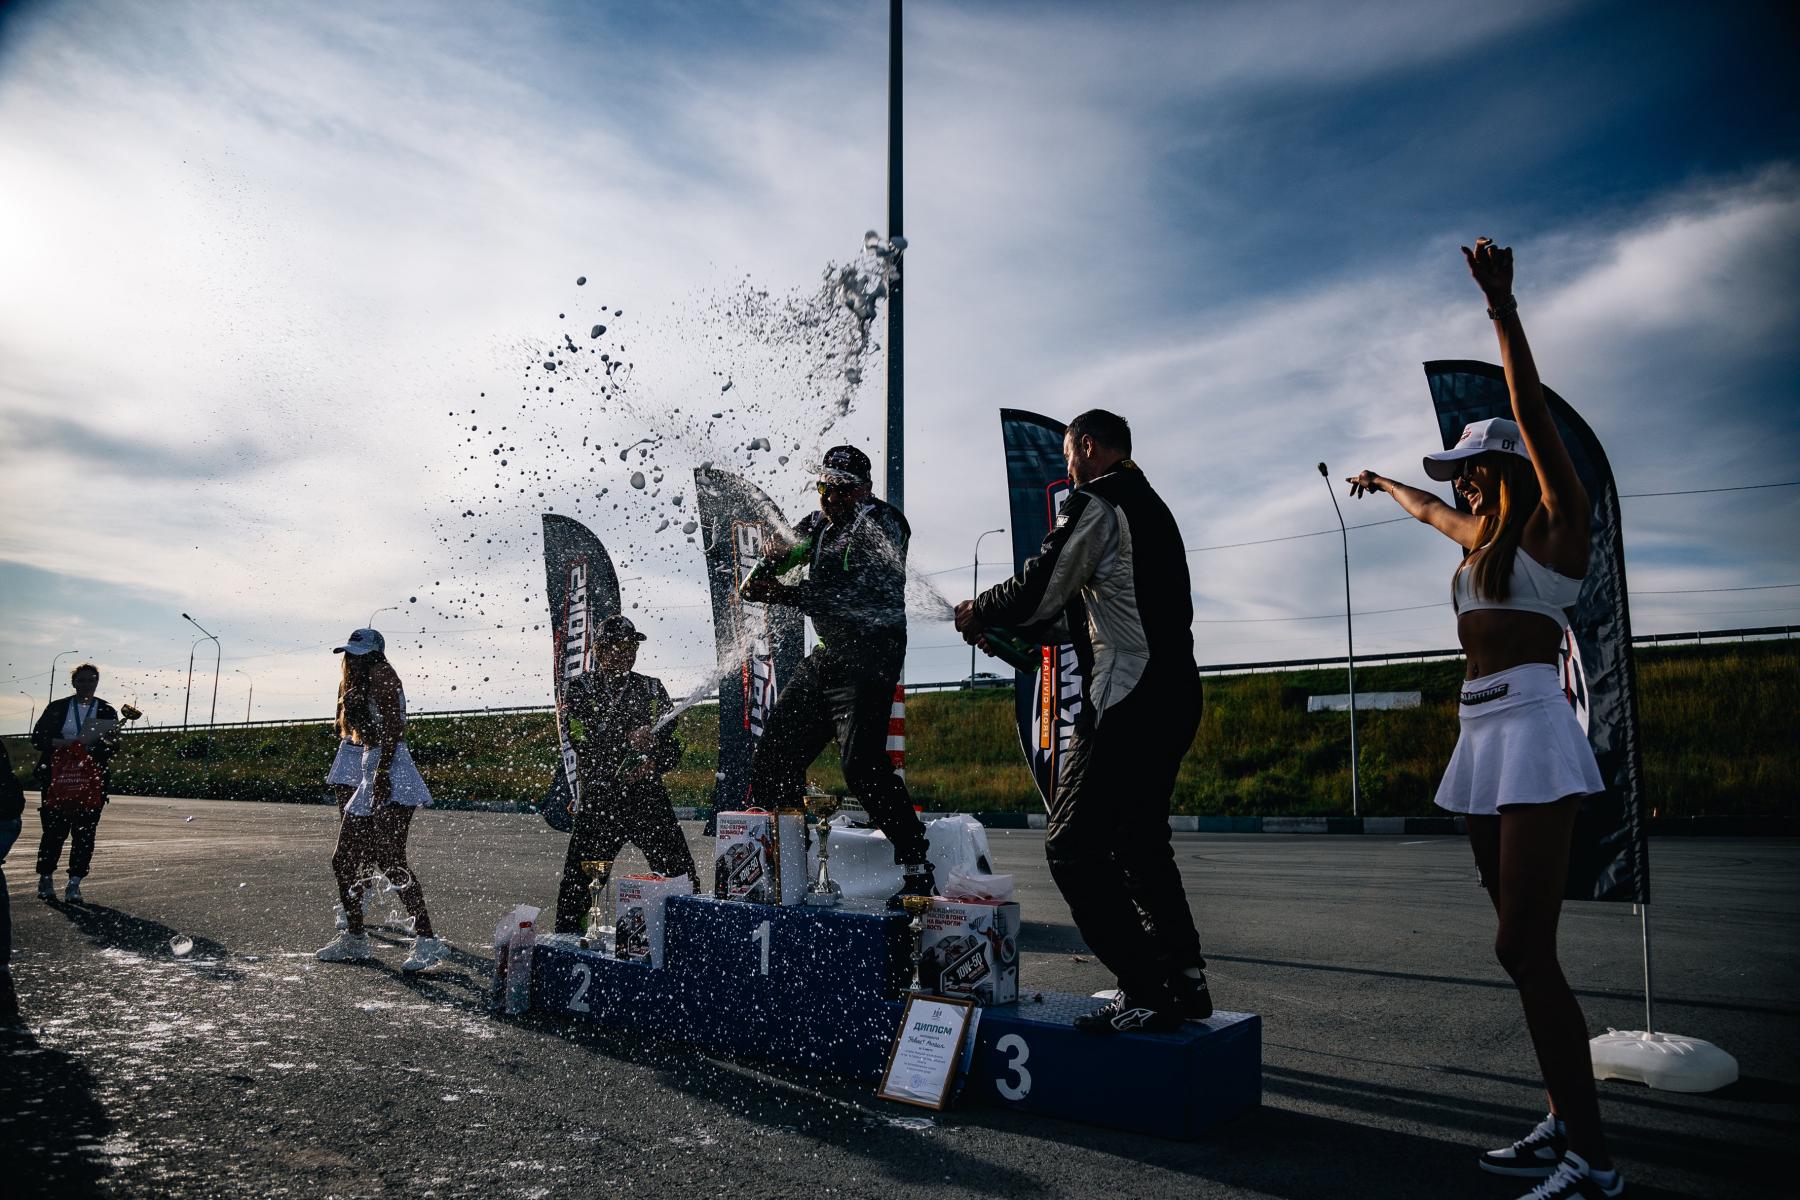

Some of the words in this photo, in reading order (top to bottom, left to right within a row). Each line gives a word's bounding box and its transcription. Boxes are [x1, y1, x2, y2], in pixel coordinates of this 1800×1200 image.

[751, 920, 771, 975] 1
[956, 952, 982, 980] 10W-50
[567, 963, 592, 1013] 2
[913, 1022, 952, 1036] ДИПЛОМ
[996, 1034, 1031, 1100] 3
